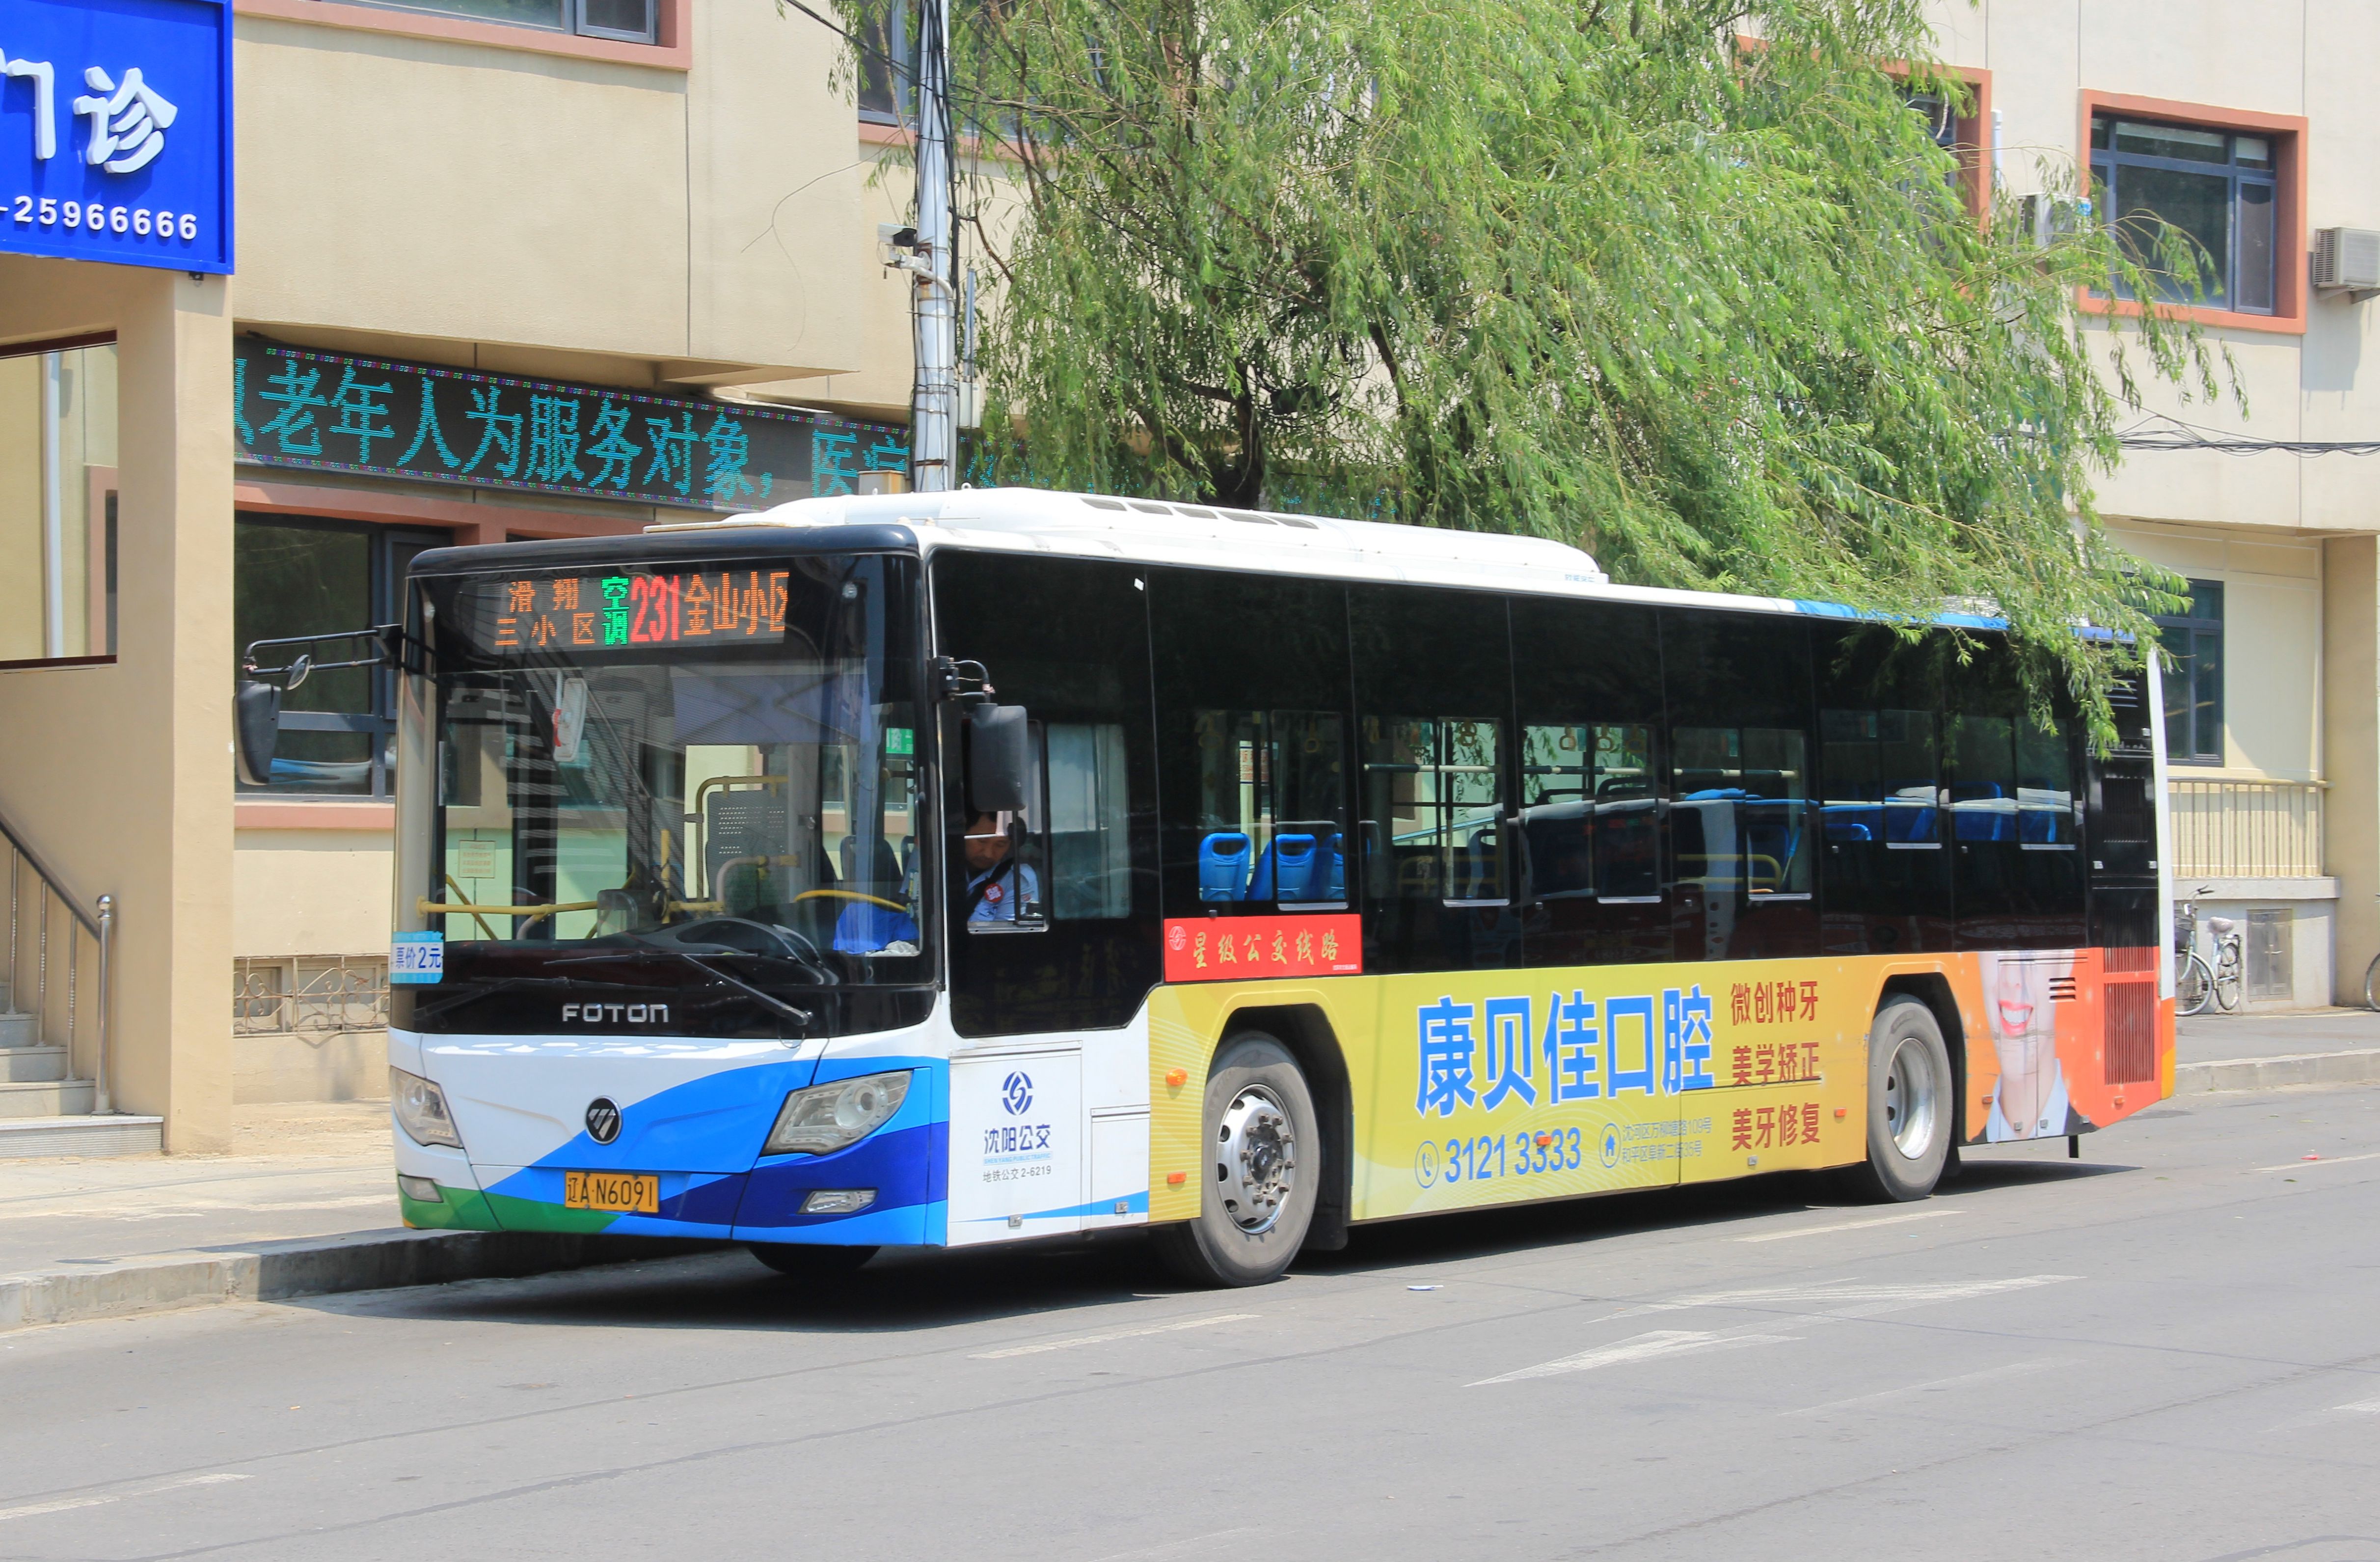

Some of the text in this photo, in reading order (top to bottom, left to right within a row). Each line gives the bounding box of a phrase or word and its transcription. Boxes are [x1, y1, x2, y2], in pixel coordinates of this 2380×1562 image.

[509, 577, 578, 612] 滑翔
[601, 576, 630, 645] 空调
[630, 575, 679, 642] 231
[683, 572, 789, 635] 金山小区
[495, 613, 595, 646] 三小区
[396, 946, 441, 969] 票价2元
[1193, 929, 1339, 968] 星级公交线路
[562, 1003, 669, 1023] FOTON
[1731, 981, 1818, 1025] 微创种牙
[1415, 984, 1714, 1119] 康贝佳口腔
[1732, 1042, 1819, 1087] 美学矫正
[984, 1124, 1051, 1154] 沈阳公交
[1732, 1103, 1820, 1151] 美牙修复
[982, 1165, 1052, 1183] 地铁公交 2-6219
[1444, 1126, 1581, 1183] 3121 3333
